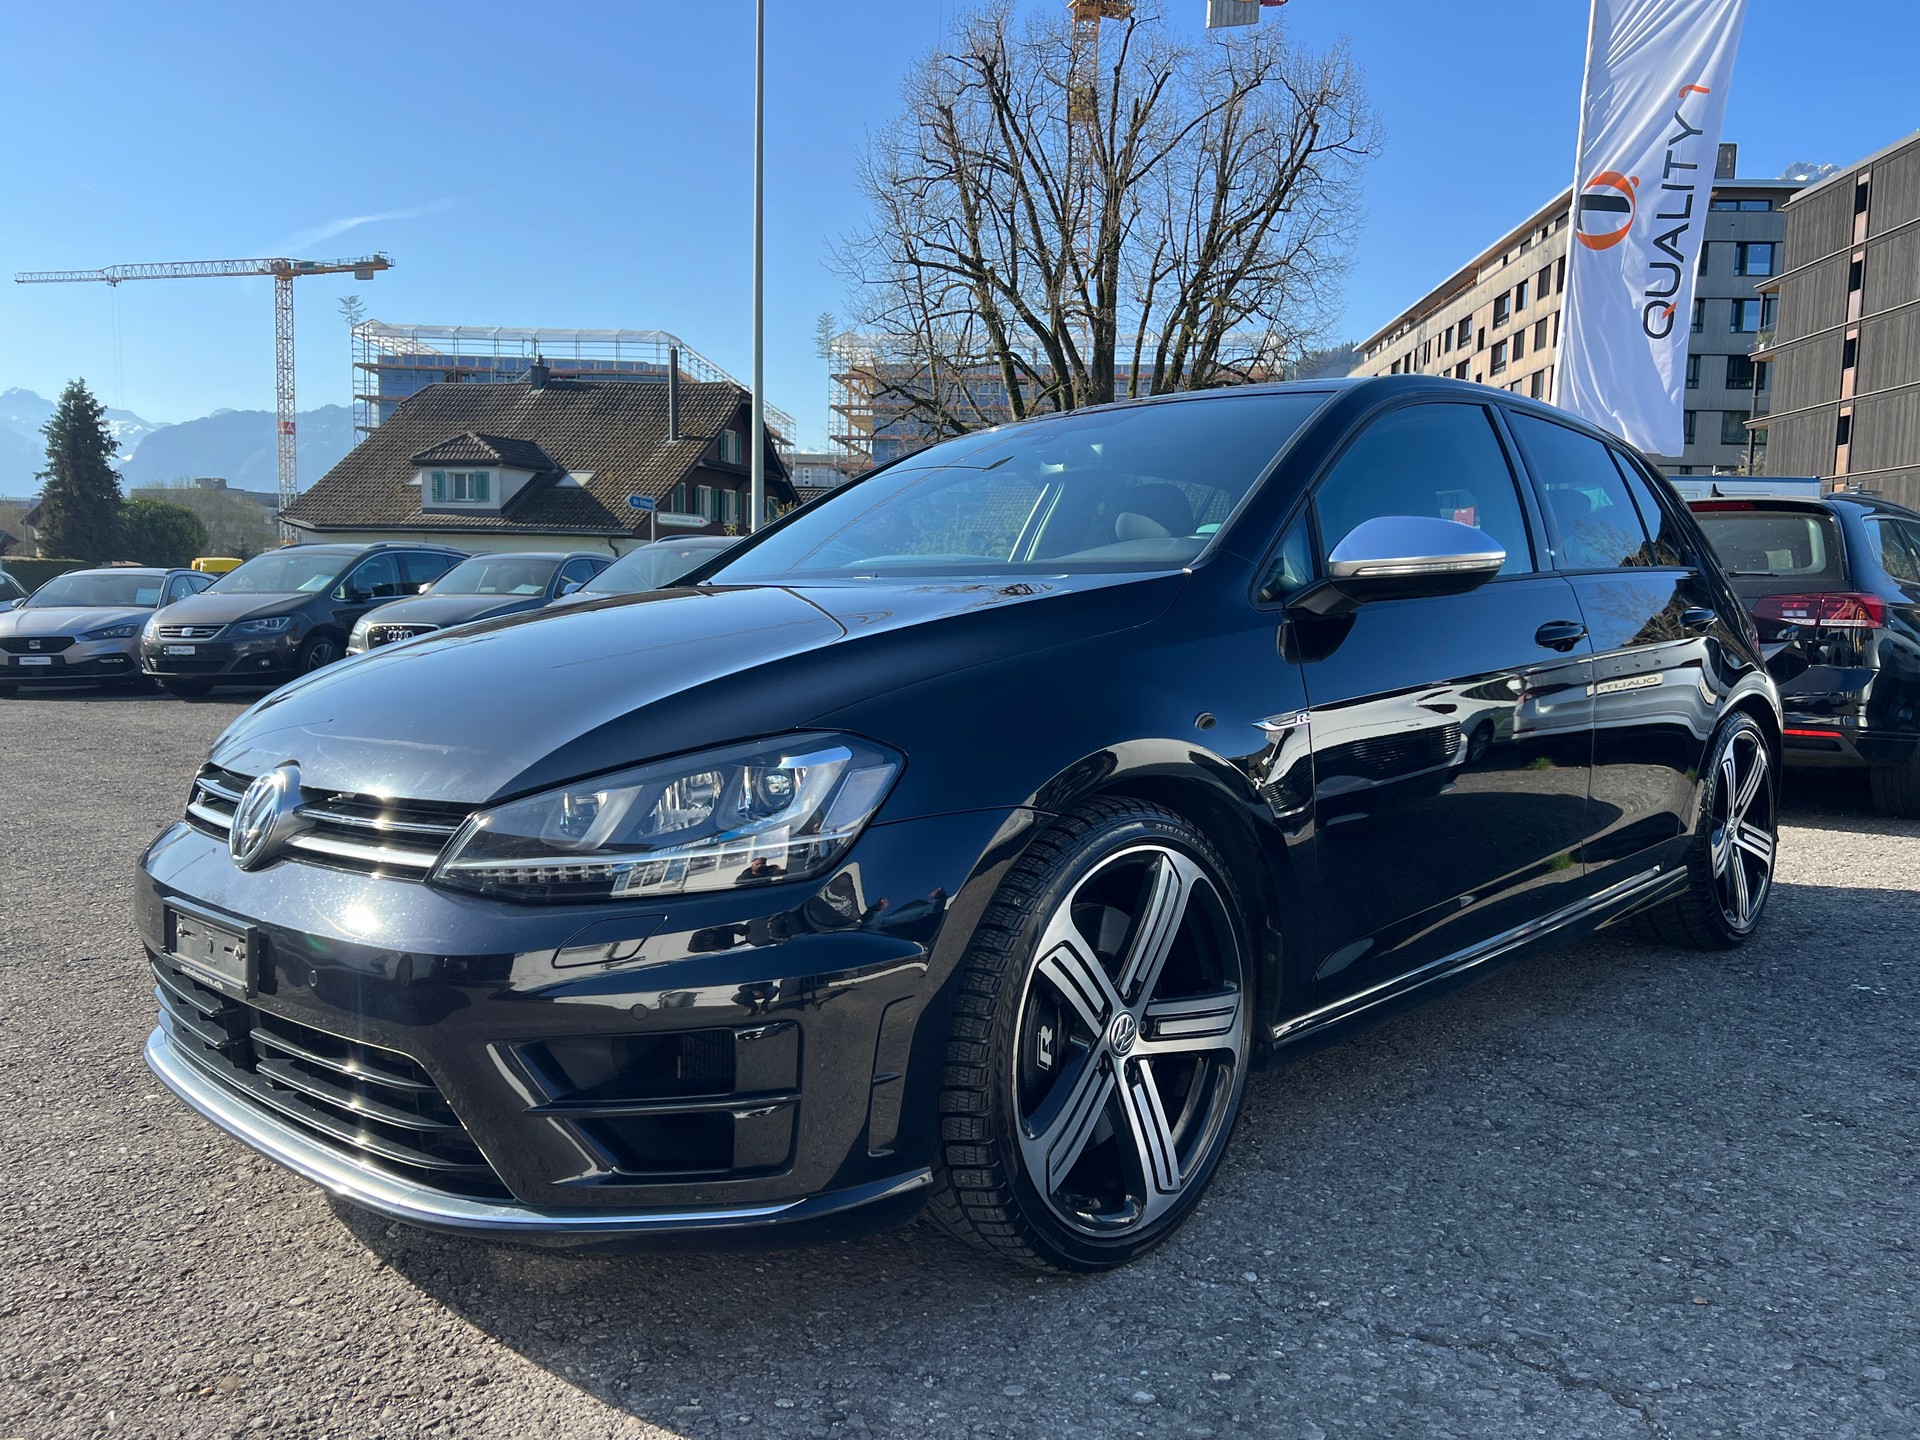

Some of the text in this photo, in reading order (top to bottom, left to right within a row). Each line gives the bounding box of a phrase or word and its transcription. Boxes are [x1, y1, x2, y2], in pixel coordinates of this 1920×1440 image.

[1642, 109, 1704, 340] QUALITY
[1296, 713, 1311, 724] R
[1155, 823, 1190, 840] 235/35
[1037, 1024, 1053, 1071] R
